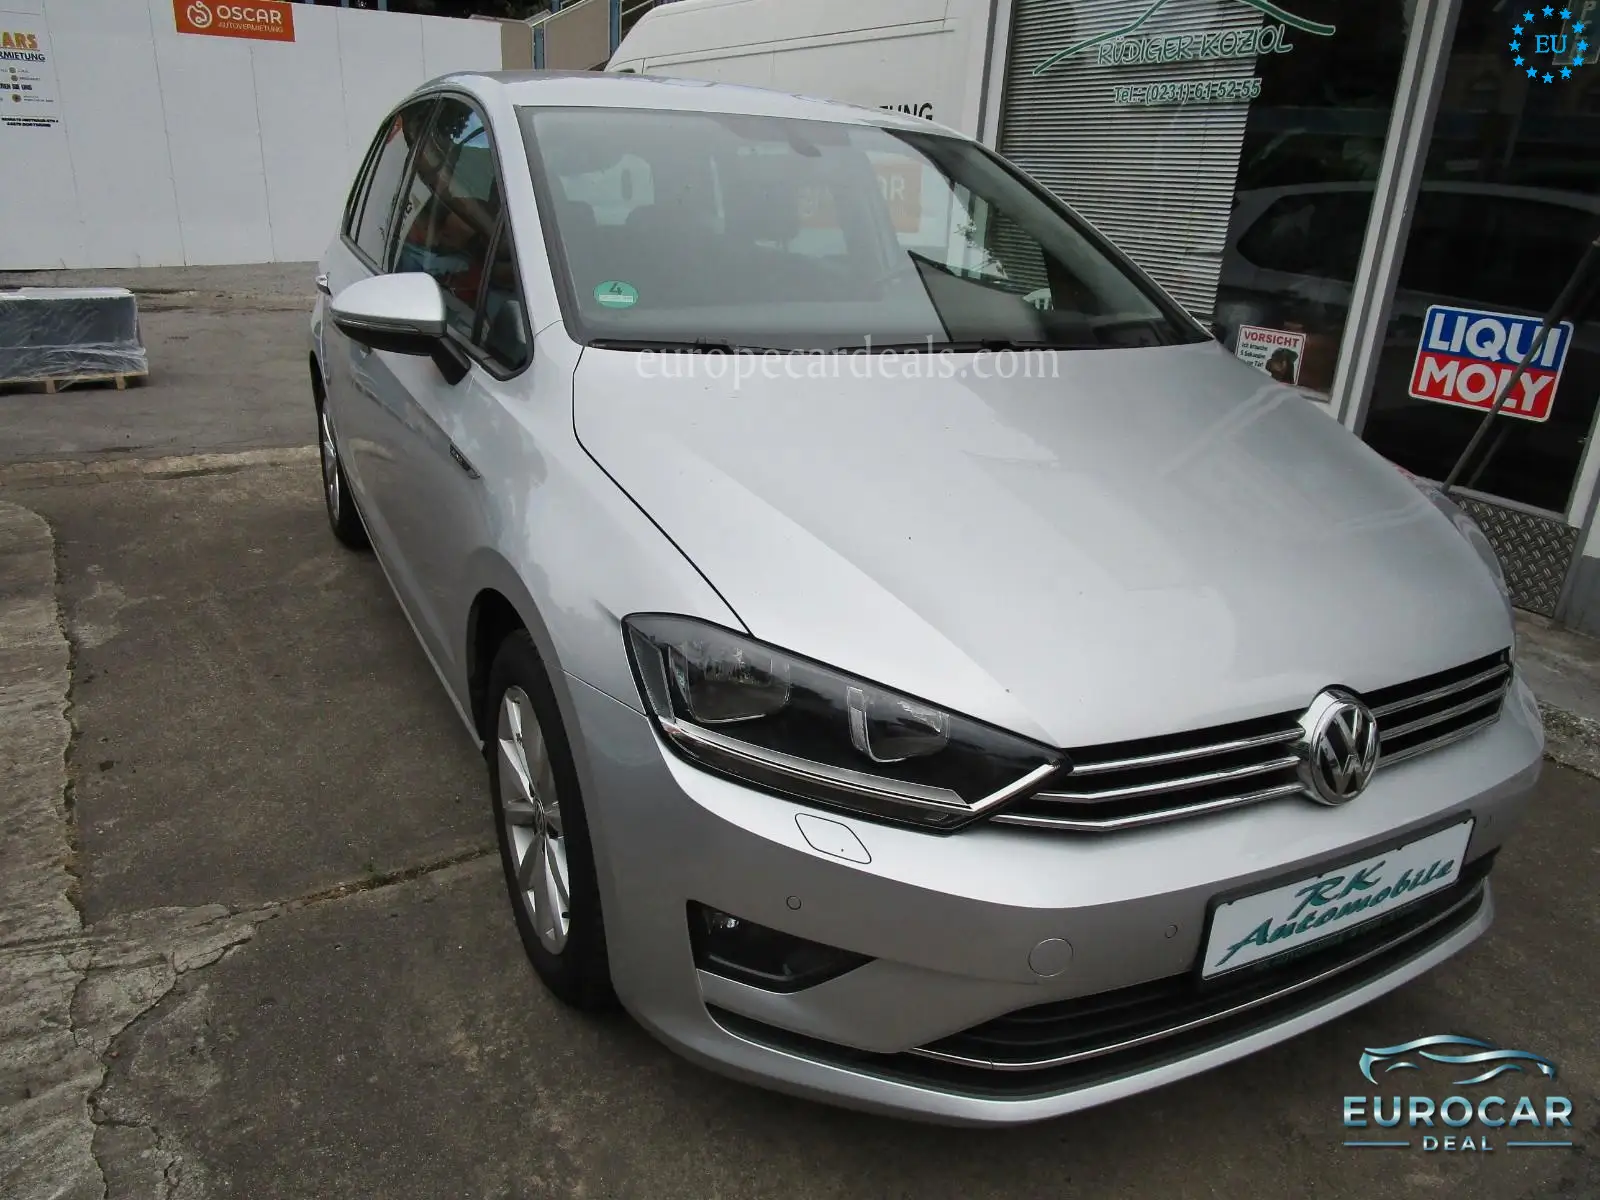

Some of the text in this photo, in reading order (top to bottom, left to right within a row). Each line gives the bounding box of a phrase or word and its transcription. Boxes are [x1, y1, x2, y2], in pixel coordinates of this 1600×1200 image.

[217, 5, 282, 25] OSCAR
[218, 21, 283, 33] AUTOVERMIETUNG
[1098, 24, 1294, 65] RÜDIGER KOZIOL
[1145, 82, 1190, 106] (0231)
[609, 281, 622, 295] 4
[1244, 331, 1299, 348] VORSICHT
[1427, 311, 1563, 369] LIQUI
[1418, 355, 1555, 412] MOLY
[1286, 860, 1387, 921] RK
[1213, 857, 1455, 968] Automobile
